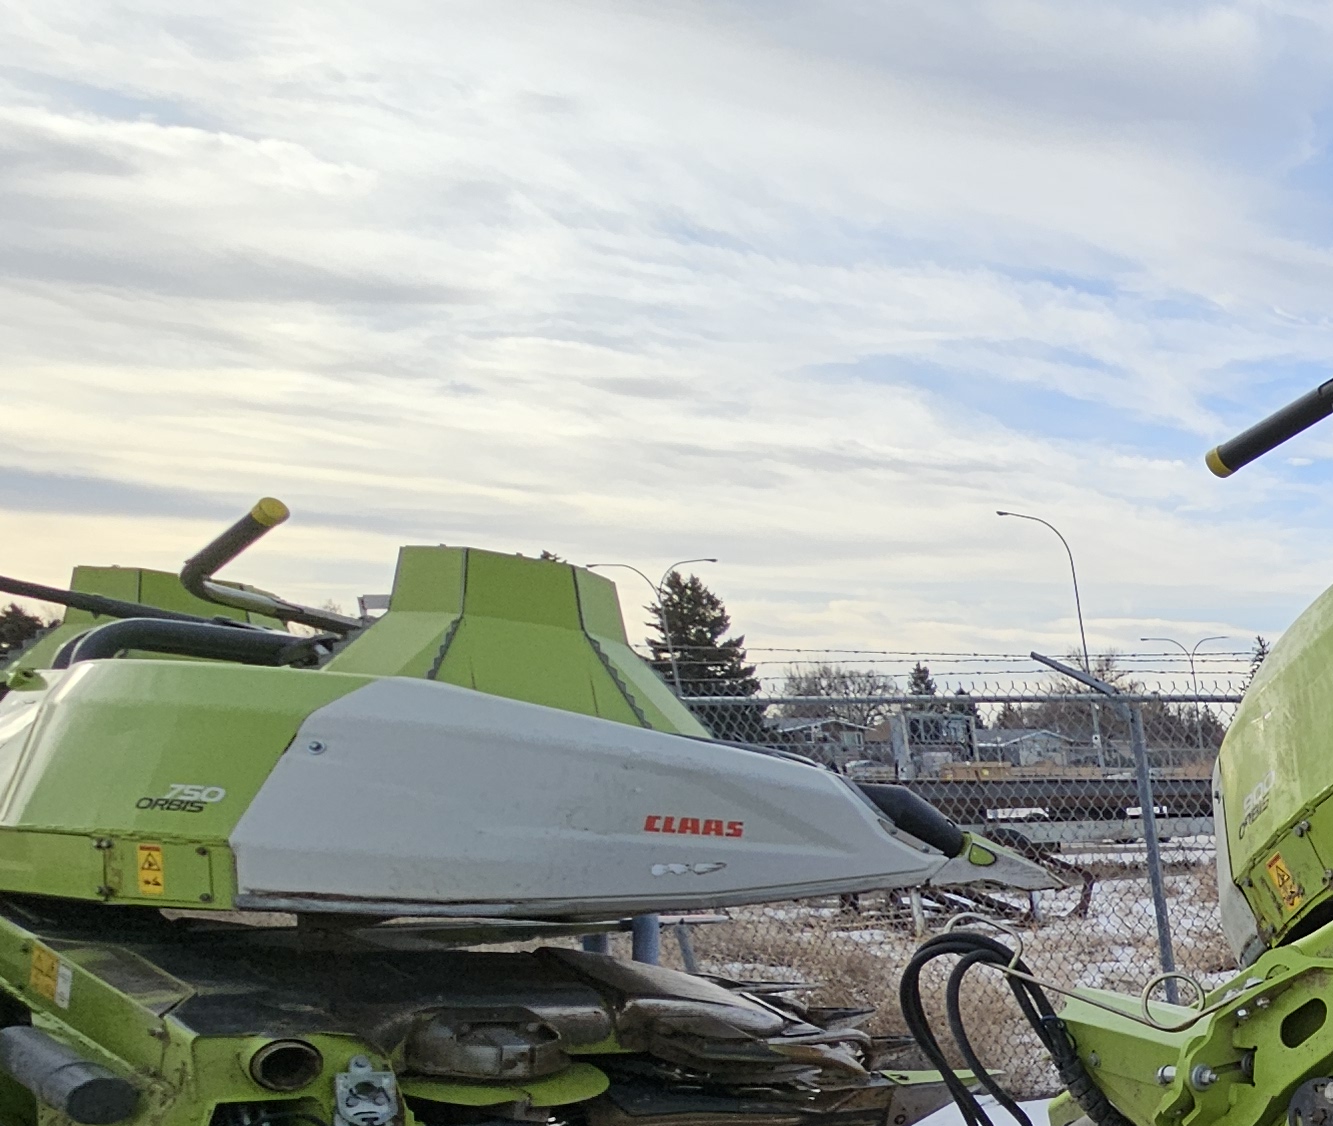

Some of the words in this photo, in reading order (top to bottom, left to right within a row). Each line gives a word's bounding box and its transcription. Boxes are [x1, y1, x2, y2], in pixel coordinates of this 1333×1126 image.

[162, 784, 226, 803] 750
[136, 797, 207, 813] ORBIS
[644, 815, 744, 838] CLAAS
